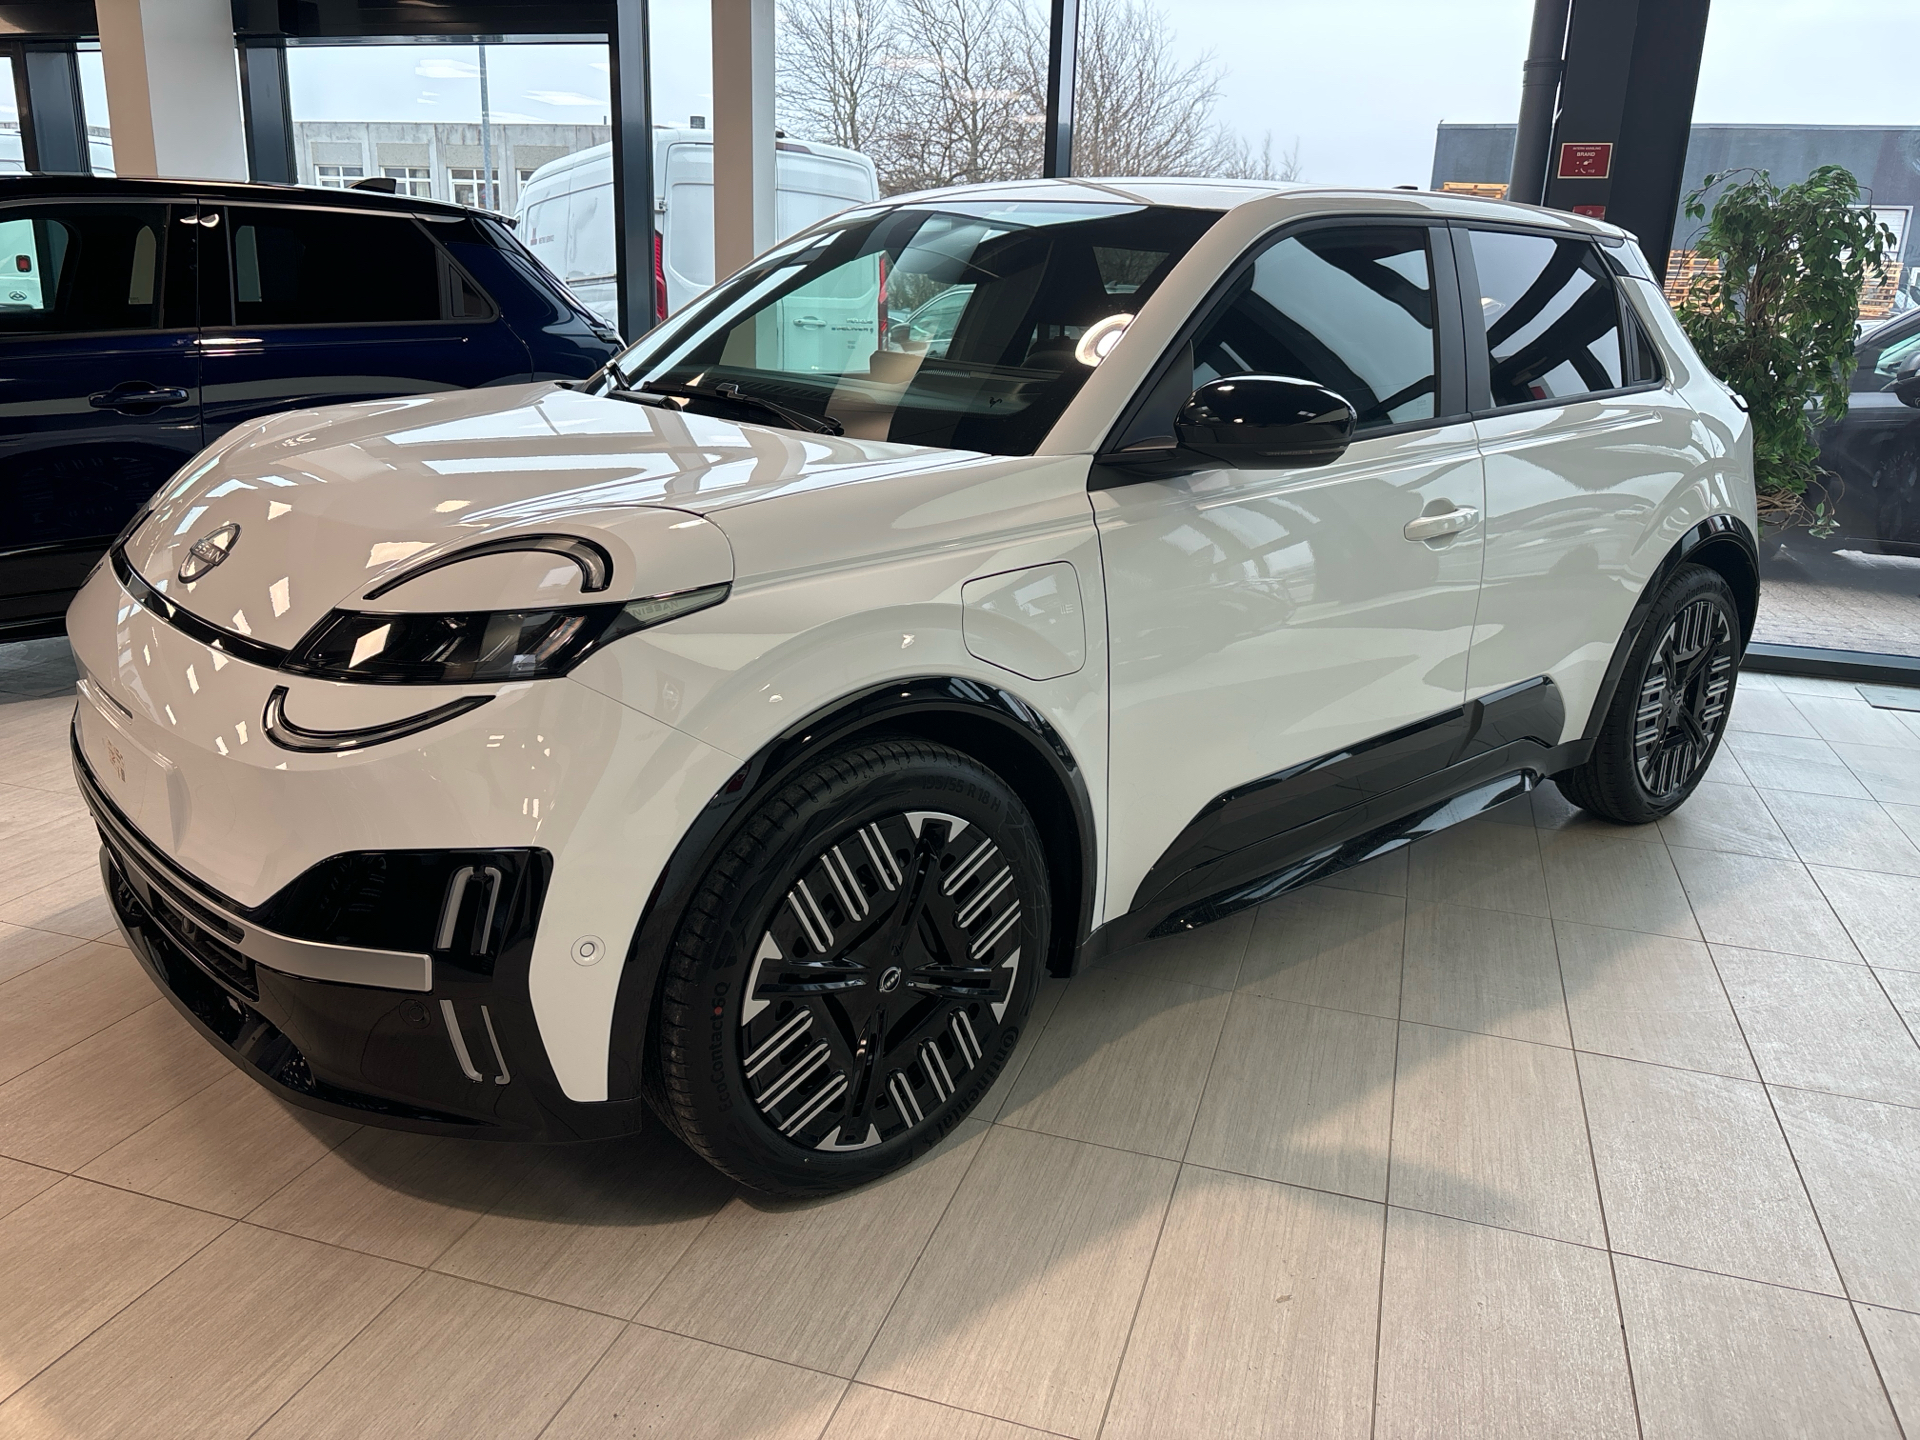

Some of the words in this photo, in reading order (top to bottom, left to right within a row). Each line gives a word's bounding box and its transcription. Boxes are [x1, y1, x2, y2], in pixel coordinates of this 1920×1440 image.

[632, 600, 679, 616] NISSAN
[1673, 580, 1713, 615] Continental
[921, 775, 965, 793] 195/55
[967, 782, 977, 798] R
[977, 787, 991, 805] 18
[990, 796, 1002, 813] H
[937, 1026, 1019, 1137] Continental
